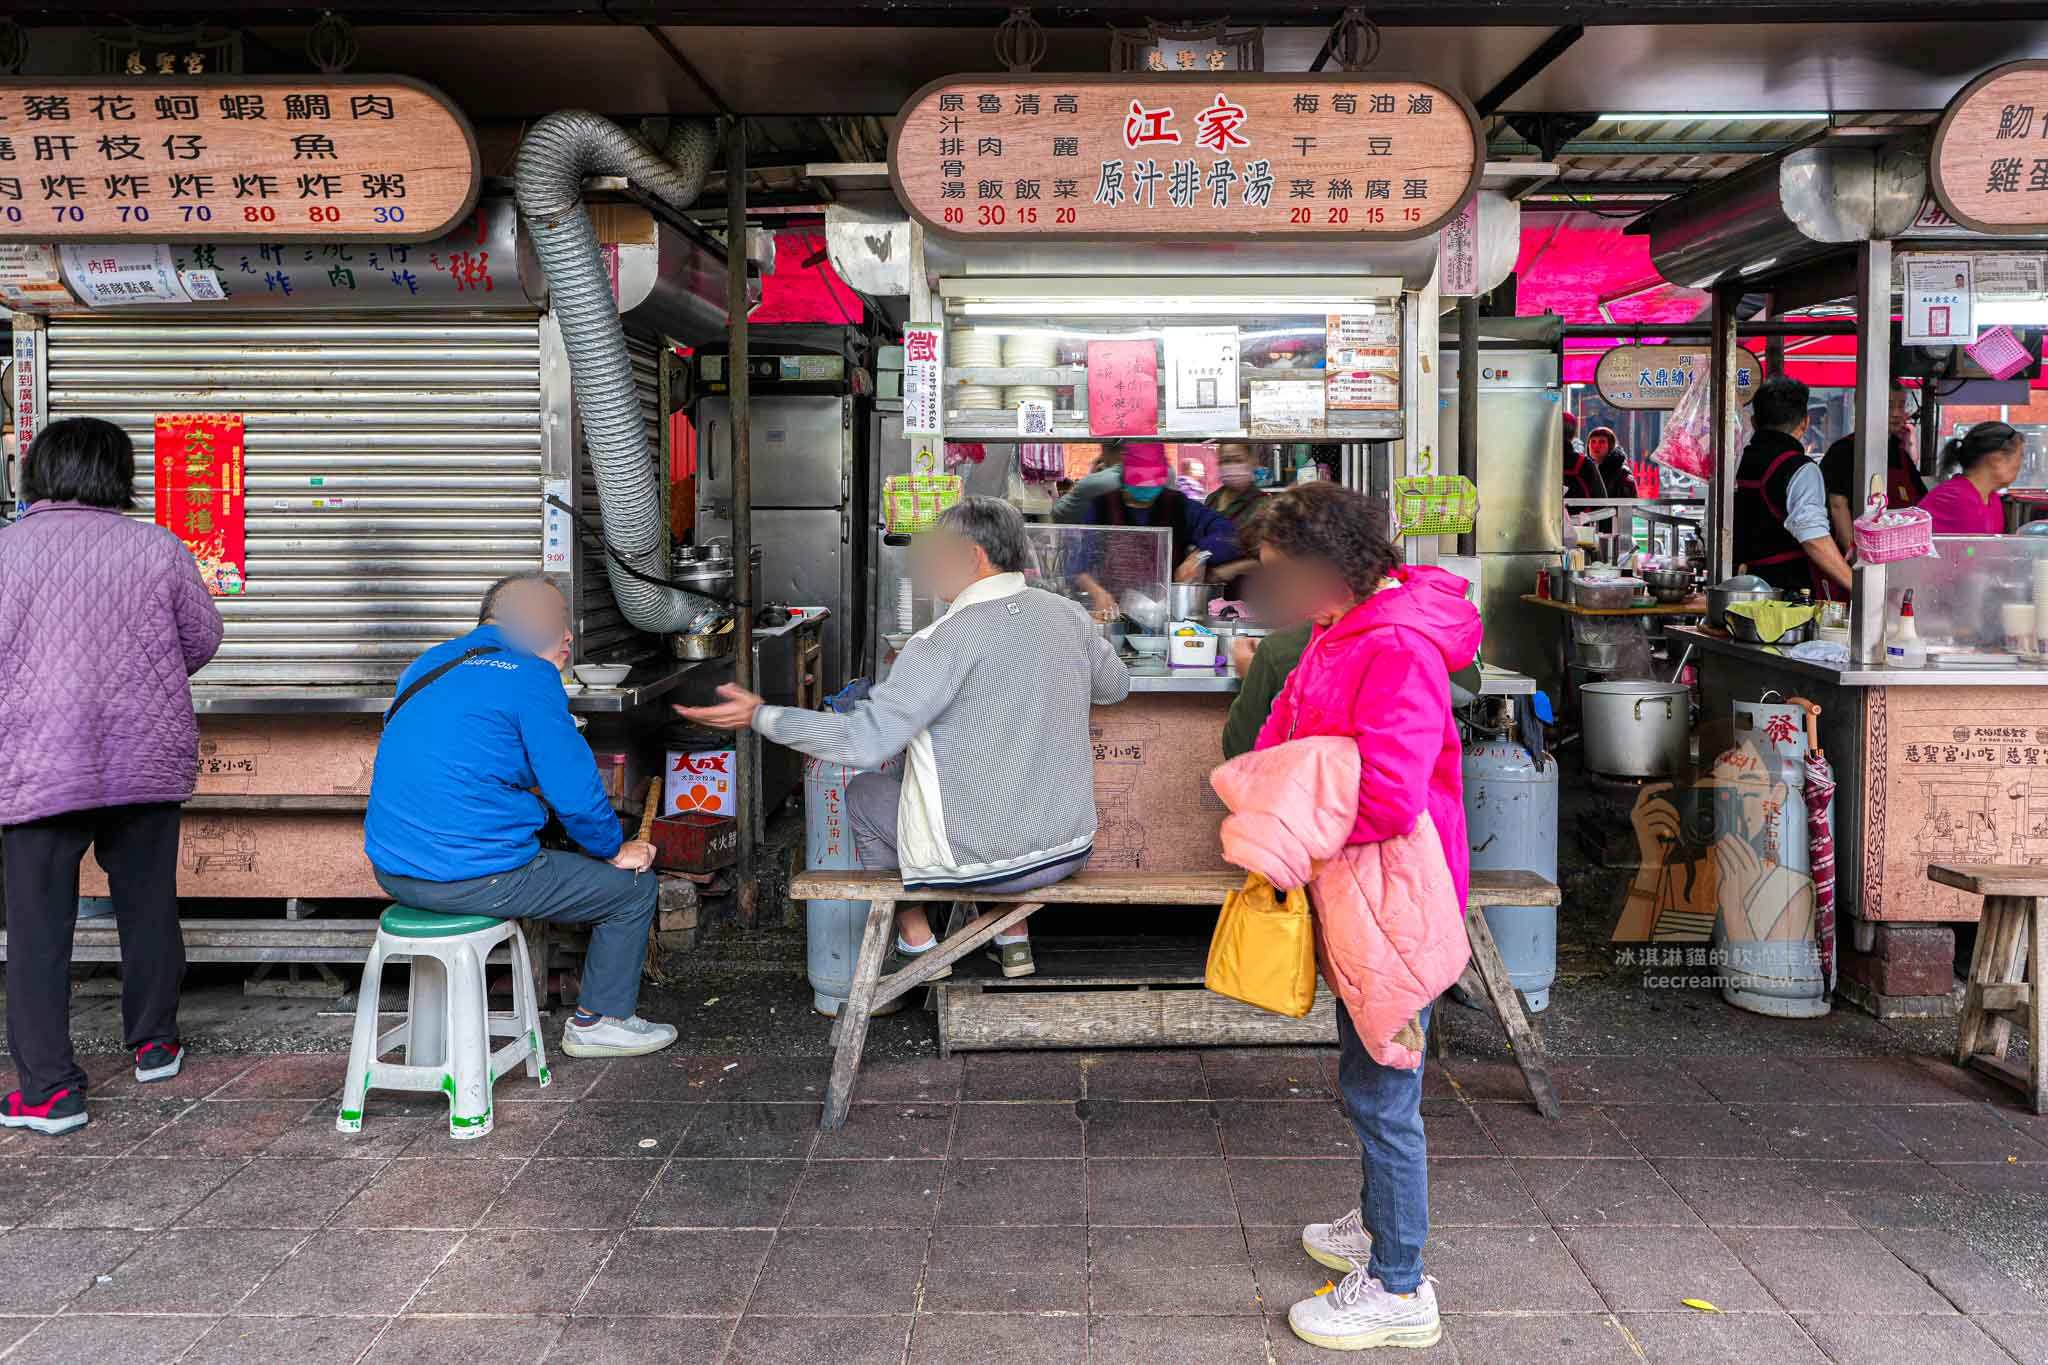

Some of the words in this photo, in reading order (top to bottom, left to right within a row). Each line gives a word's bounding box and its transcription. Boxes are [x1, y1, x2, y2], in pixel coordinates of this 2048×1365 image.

[1124, 94, 1250, 153] 江家
[1996, 104, 2048, 139] 魩
[23, 95, 88, 200] 豬肝炸
[88, 95, 151, 199] 花枝炸
[154, 95, 215, 199] 蚵仔炸
[282, 94, 344, 199] 鯛魚炸
[939, 94, 966, 199] 原汁排骨湯
[1095, 159, 1274, 207] 原汁排骨湯
[52, 206, 85, 222] 70
[116, 206, 149, 222] 70
[178, 205, 212, 222] 70
[243, 206, 275, 223] 80
[308, 206, 340, 223] 80
[373, 206, 405, 223] 30
[944, 207, 964, 224] 80
[978, 205, 1005, 225] 30
[1017, 207, 1037, 223] 15
[1055, 207, 1076, 223] 20
[1290, 207, 1311, 224] 20
[1328, 207, 1348, 224] 20
[1367, 207, 1384, 224] 15
[1404, 207, 1421, 222] 15
[907, 331, 938, 361] 徵
[1763, 714, 1799, 751] 發
[672, 752, 729, 774] 大成
[1905, 744, 1996, 763] 慈聖宮小吃
[2006, 746, 2048, 765] 慈聖
